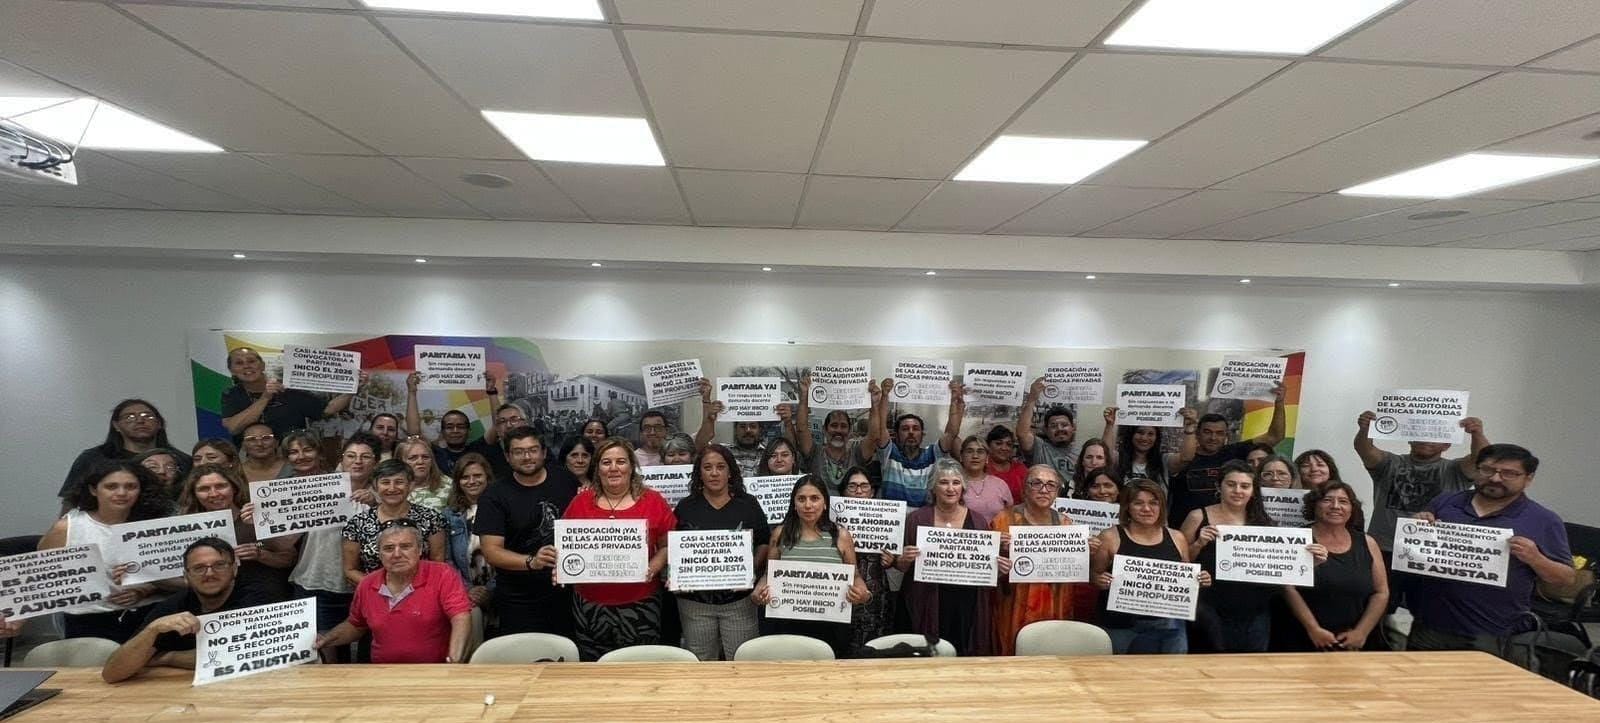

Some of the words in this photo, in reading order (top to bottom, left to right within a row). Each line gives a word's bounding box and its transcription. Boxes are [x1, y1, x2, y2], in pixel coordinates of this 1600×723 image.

[261, 500, 277, 509] NO
[280, 498, 294, 506] ES
[296, 491, 346, 504] AHORRAR
[292, 501, 338, 512] RECORTAR
[286, 509, 335, 521] DERECHOS
[270, 523, 287, 534] ES
[290, 514, 347, 531] AJUSTAR
[928, 530, 945, 538] CASI
[1459, 526, 1501, 535] LICENCIAS
[706, 534, 729, 542] MESES
[926, 536, 985, 546] CONVOCATORIA
[1404, 537, 1421, 545] NO
[1424, 539, 1438, 548] ES
[680, 541, 737, 549] CONVOCATORIA
[723, 555, 744, 563] 2026
[969, 553, 991, 562] 2026
[1434, 550, 1490, 561] RECORTAR
[678, 565, 692, 573] SIN
[695, 564, 747, 573] PROPUESTA
[923, 559, 938, 567] SIN
[940, 560, 992, 570] PROPUESTA
[1126, 559, 1144, 567] CASI
[1152, 562, 1178, 570] MESES
[1407, 561, 1425, 571] ES
[1427, 557, 1483, 569] DERECHOS
[1124, 565, 1185, 578] CONVOCATORIA
[2, 578, 21, 588] ES
[1137, 573, 1178, 583] PARITARIA
[20, 576, 87, 592] RECORTAR
[1167, 585, 1190, 594] 2026
[13, 585, 82, 604] DERECHOS
[1119, 588, 1134, 597] SIN
[1136, 590, 1191, 603] PROPUESTA
[219, 608, 265, 620] RECHAZAR
[267, 600, 307, 613] LICENCIAS
[244, 608, 304, 624] TRATAMIENTOS
[208, 637, 228, 647] NO
[231, 633, 247, 643] ES
[250, 621, 309, 640] AHORRAR
[244, 633, 300, 649] RECORTAR
[237, 643, 294, 661] DERECHOS
[214, 665, 235, 677] ES
